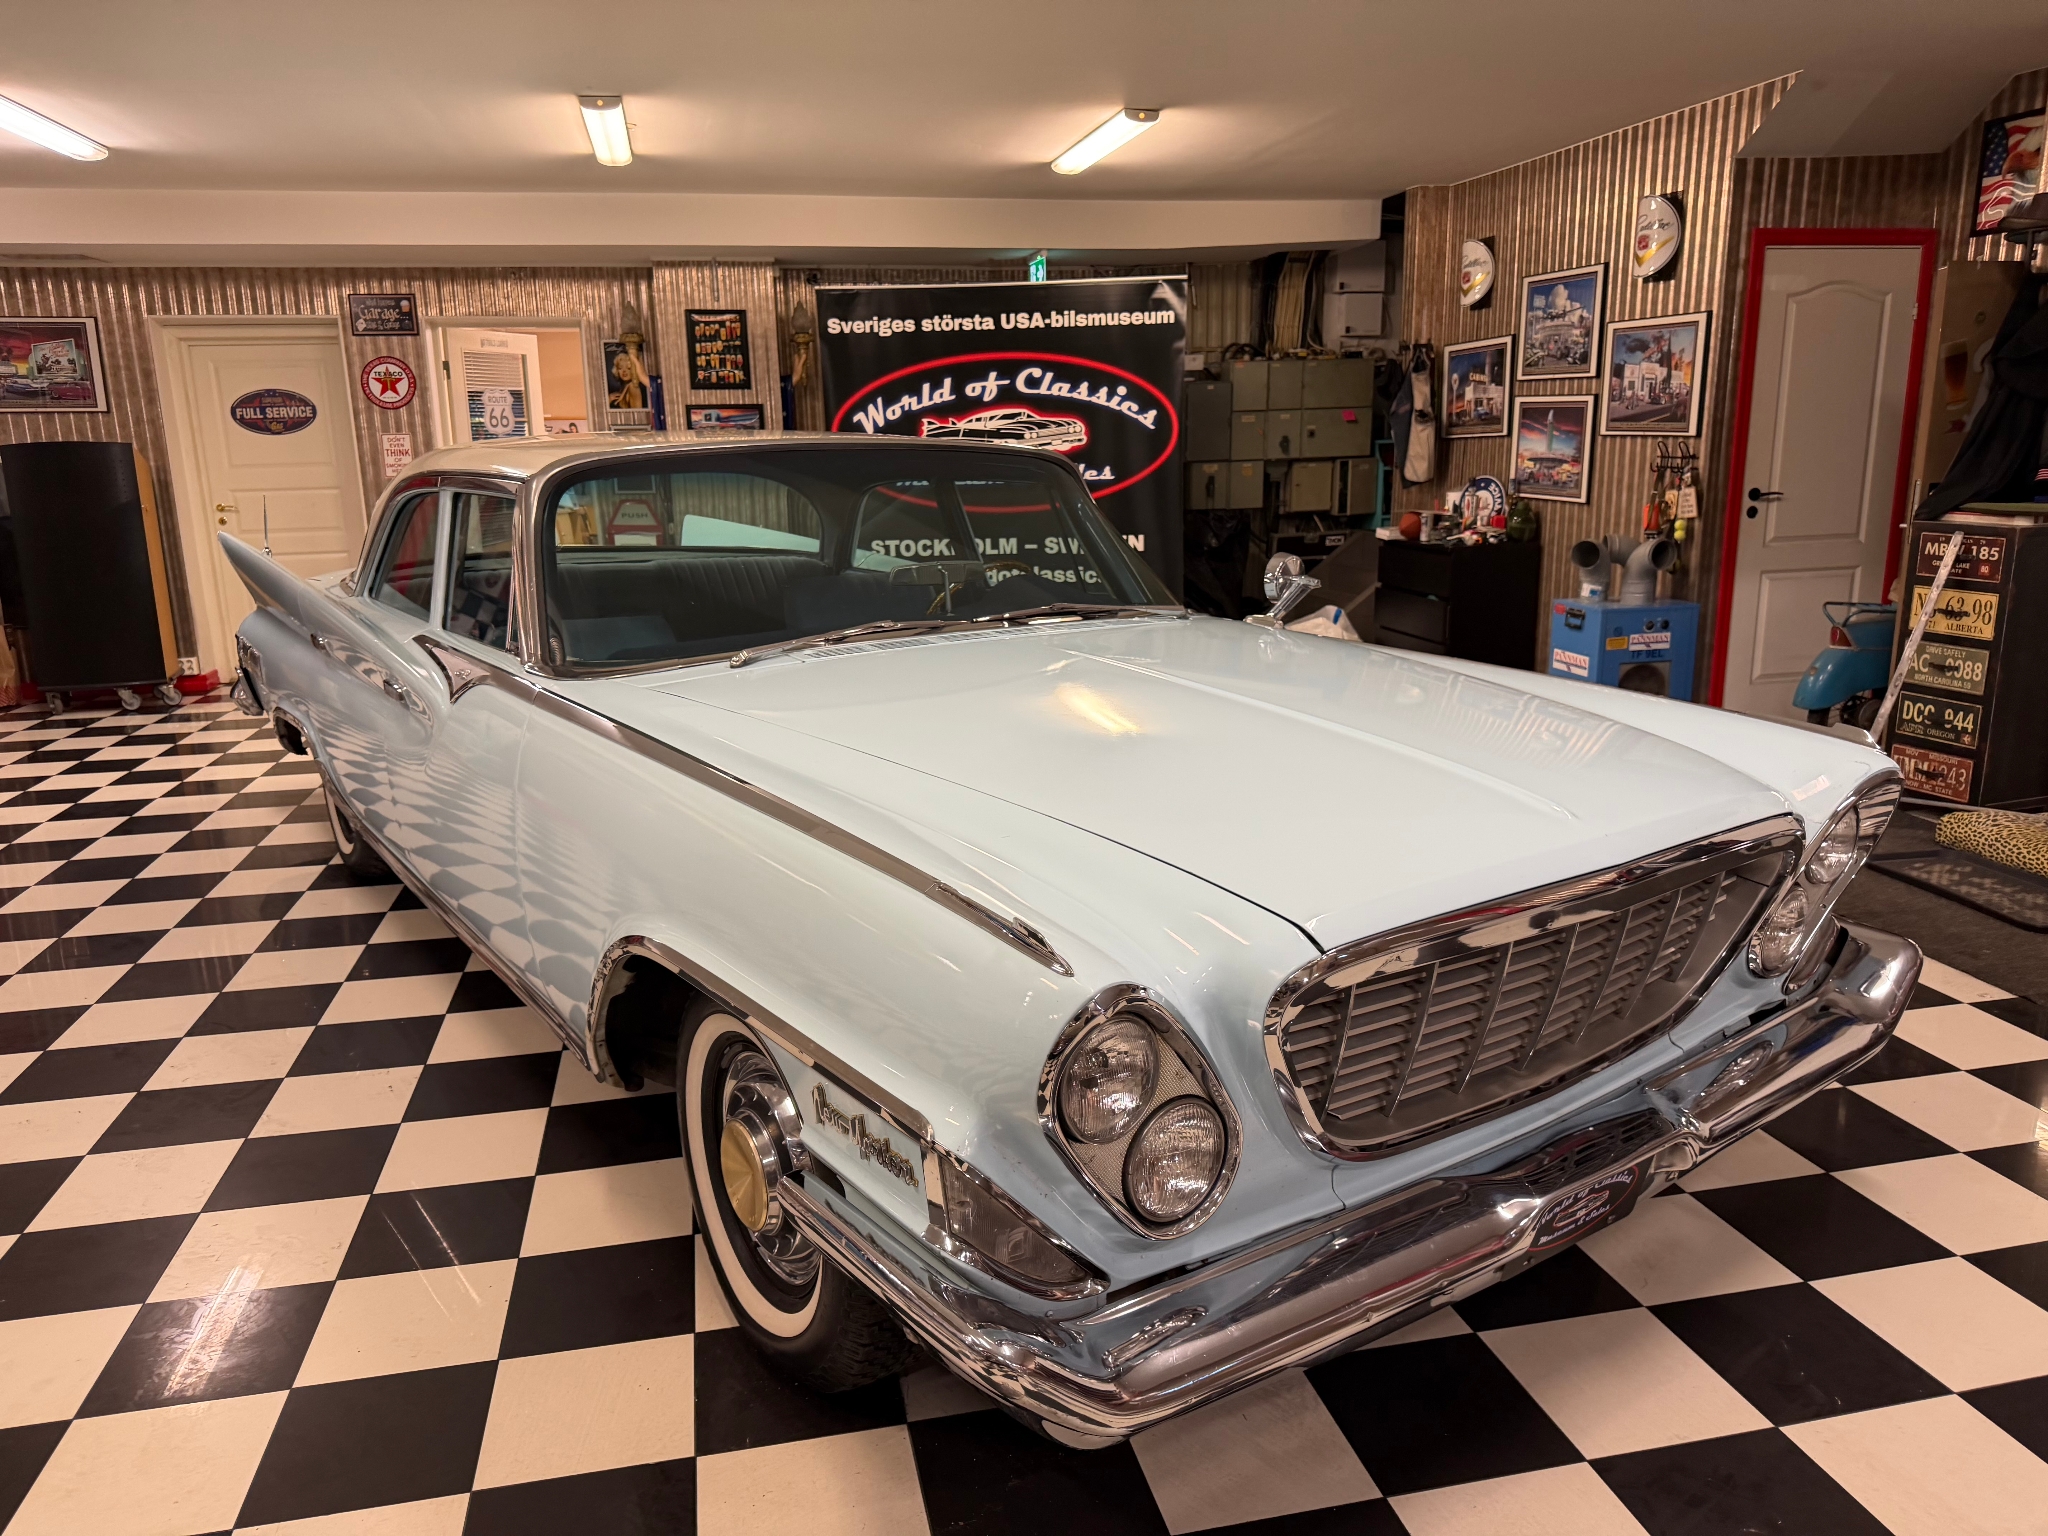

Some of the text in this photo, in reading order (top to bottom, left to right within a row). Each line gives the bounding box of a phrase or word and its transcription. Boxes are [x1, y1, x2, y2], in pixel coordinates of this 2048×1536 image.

[826, 310, 1176, 337] Sveriges största USA-bilsmuseum
[487, 395, 508, 404] ROUTE
[853, 367, 1159, 434] World of Classics
[235, 406, 314, 420] FULL SERVICE
[489, 407, 510, 429] 66
[385, 448, 411, 457] THINK
[870, 536, 1018, 558] STOCKOLM
[1971, 545, 2000, 561] 185
[1971, 598, 1994, 626] 98
[1944, 622, 1984, 635] ALBERTA
[1925, 645, 1967, 658] DRIVE SAFELY
[1914, 673, 1932, 683] NORTH
[1933, 676, 1963, 688] CAROLINA
[1926, 728, 1956, 740] OREGON
[1928, 753, 1958, 765] MISSOURI
[1935, 786, 1953, 796] STATE
[1537, 1223, 1576, 1246] Museum
[1585, 1203, 1611, 1222] Sales
